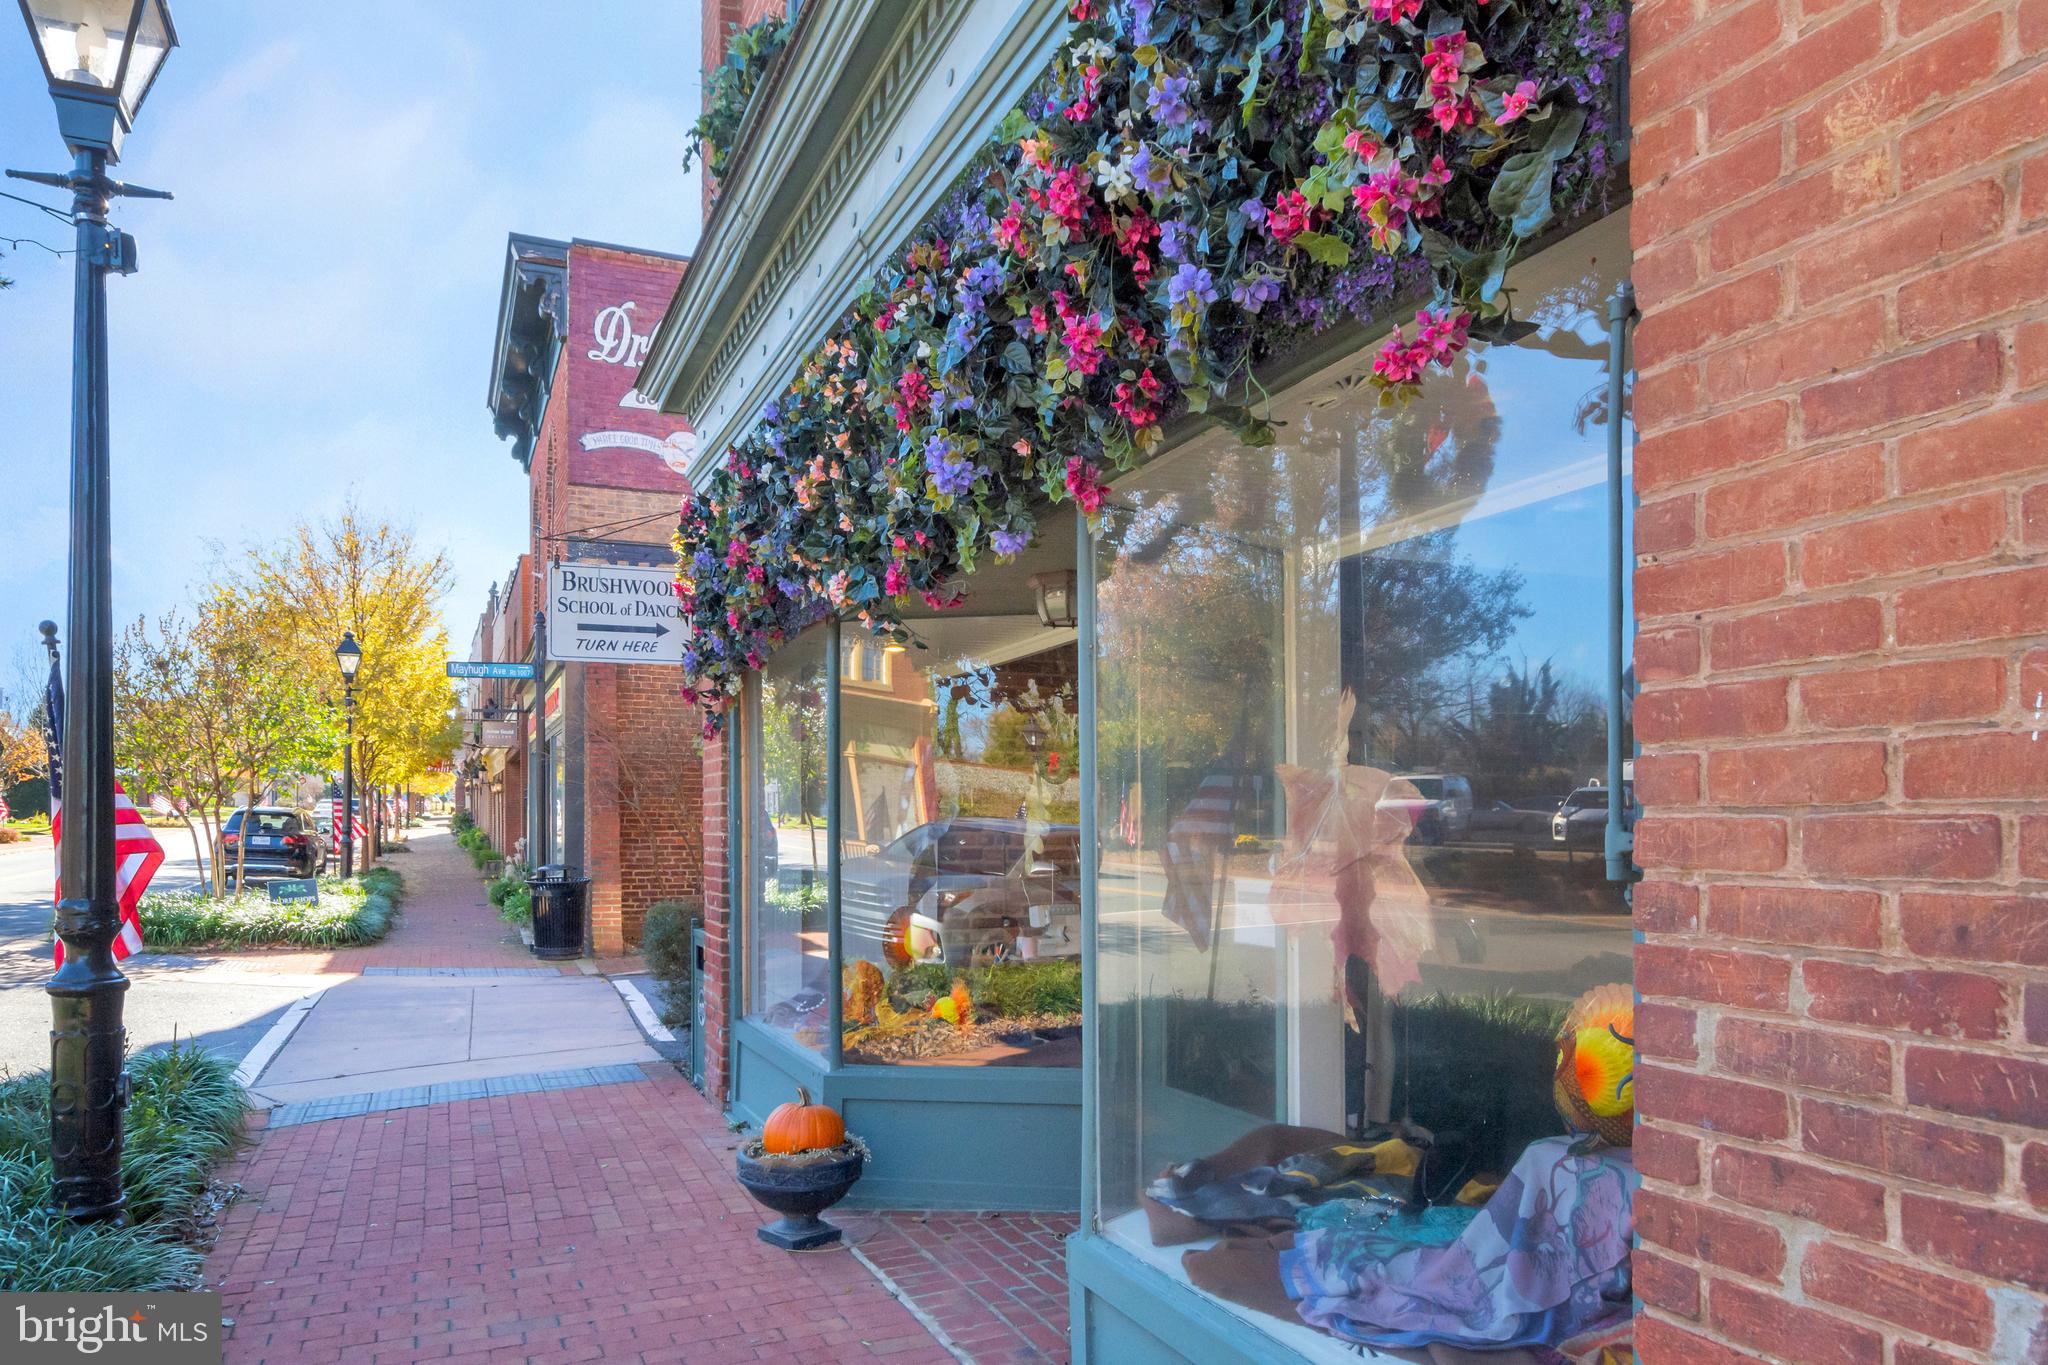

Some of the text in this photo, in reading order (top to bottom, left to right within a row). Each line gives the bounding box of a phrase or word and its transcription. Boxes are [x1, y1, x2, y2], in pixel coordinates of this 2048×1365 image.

[557, 597, 617, 615] SCHOOL
[620, 603, 632, 617] of
[576, 638, 659, 653] TURN HERE
[451, 663, 488, 677] Mayhugh
[492, 667, 506, 675] Ave
